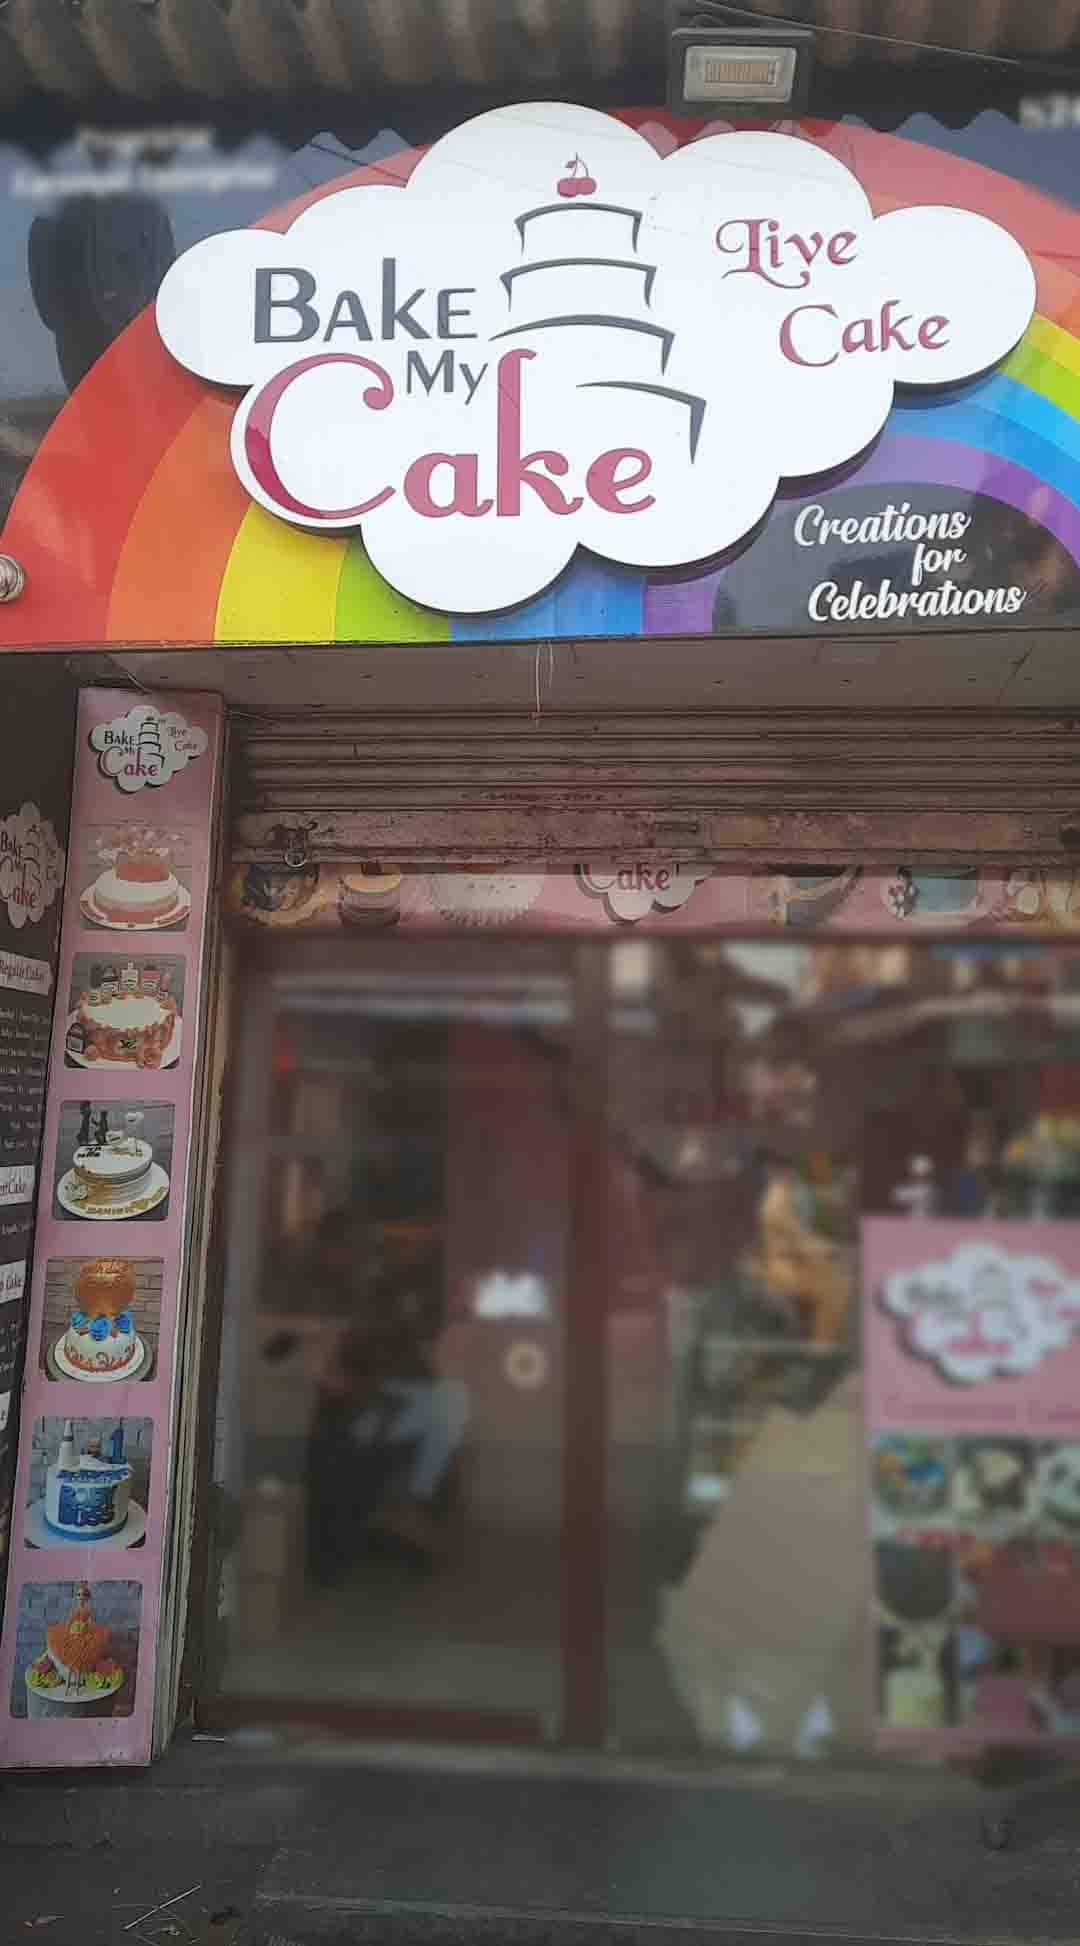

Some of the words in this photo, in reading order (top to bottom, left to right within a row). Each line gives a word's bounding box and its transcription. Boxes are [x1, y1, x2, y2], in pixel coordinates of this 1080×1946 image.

[715, 218, 859, 289] Live
[779, 299, 951, 368] Cake
[405, 350, 489, 405] My
[244, 348, 656, 519] Cake
[793, 502, 972, 547] Creations
[911, 544, 968, 586] for
[807, 581, 1028, 622] Celebrations
